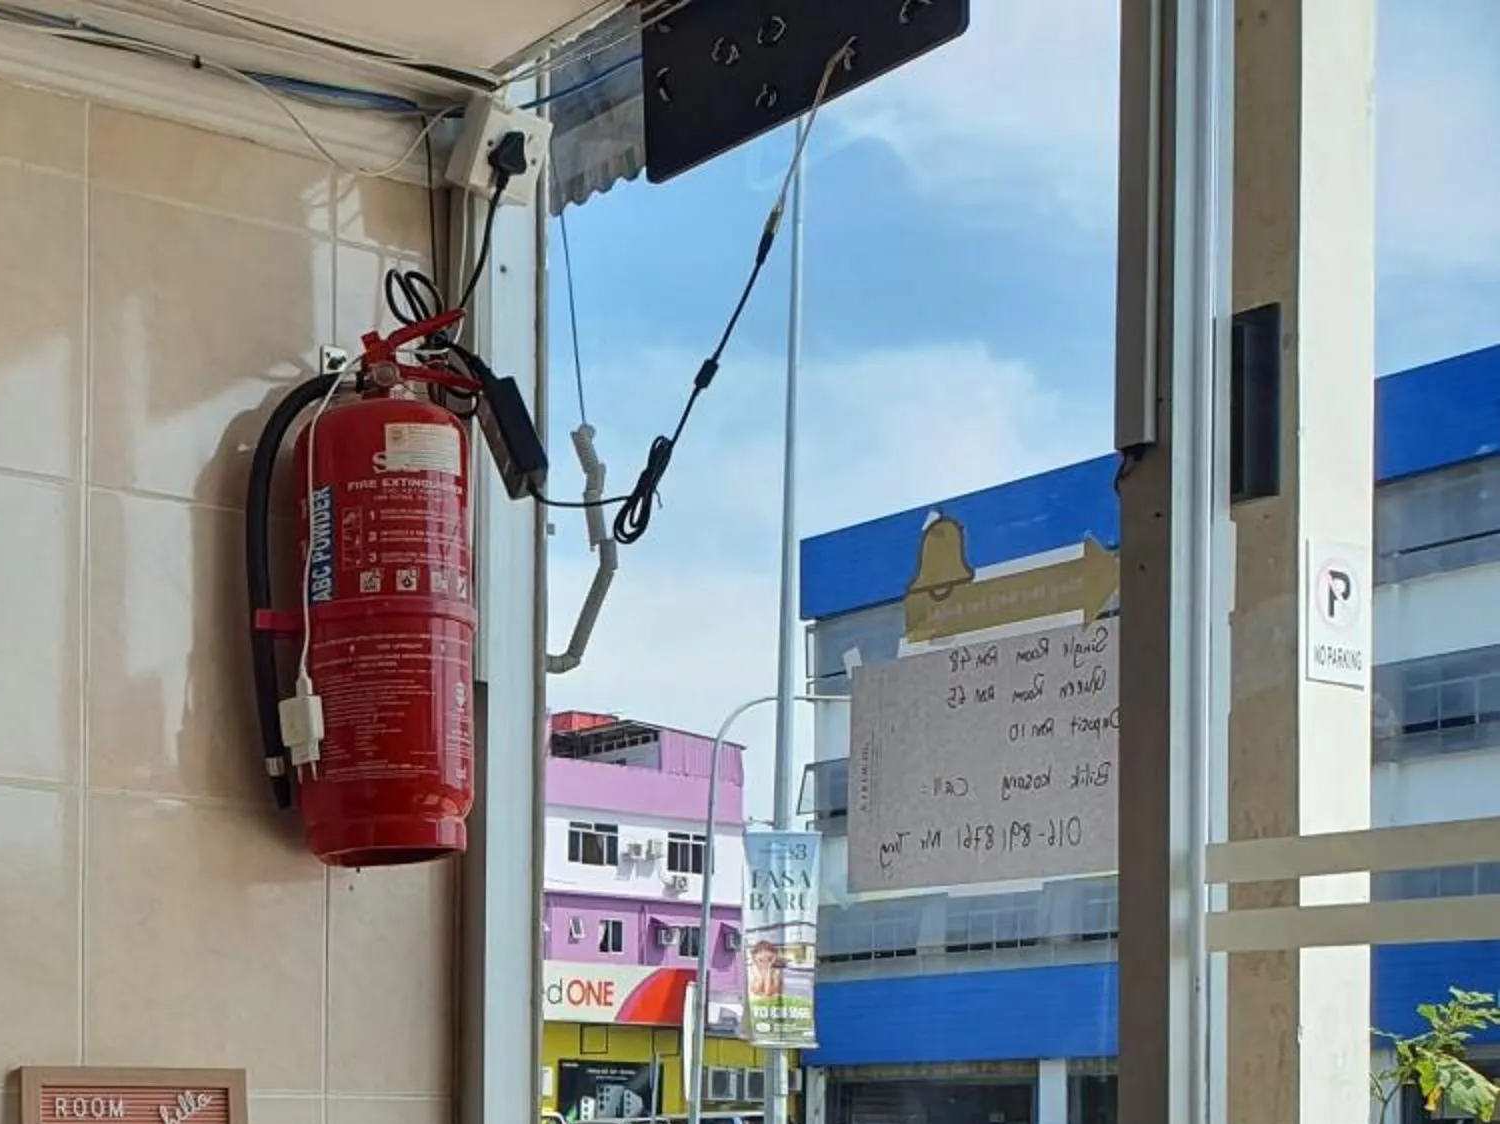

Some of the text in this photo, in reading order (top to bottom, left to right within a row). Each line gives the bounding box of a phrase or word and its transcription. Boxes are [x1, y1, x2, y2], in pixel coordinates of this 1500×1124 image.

[311, 486, 332, 600] ABC POWDER
[1314, 643, 1362, 671] NO PARKING
[55, 1097, 125, 1119] ROOM
